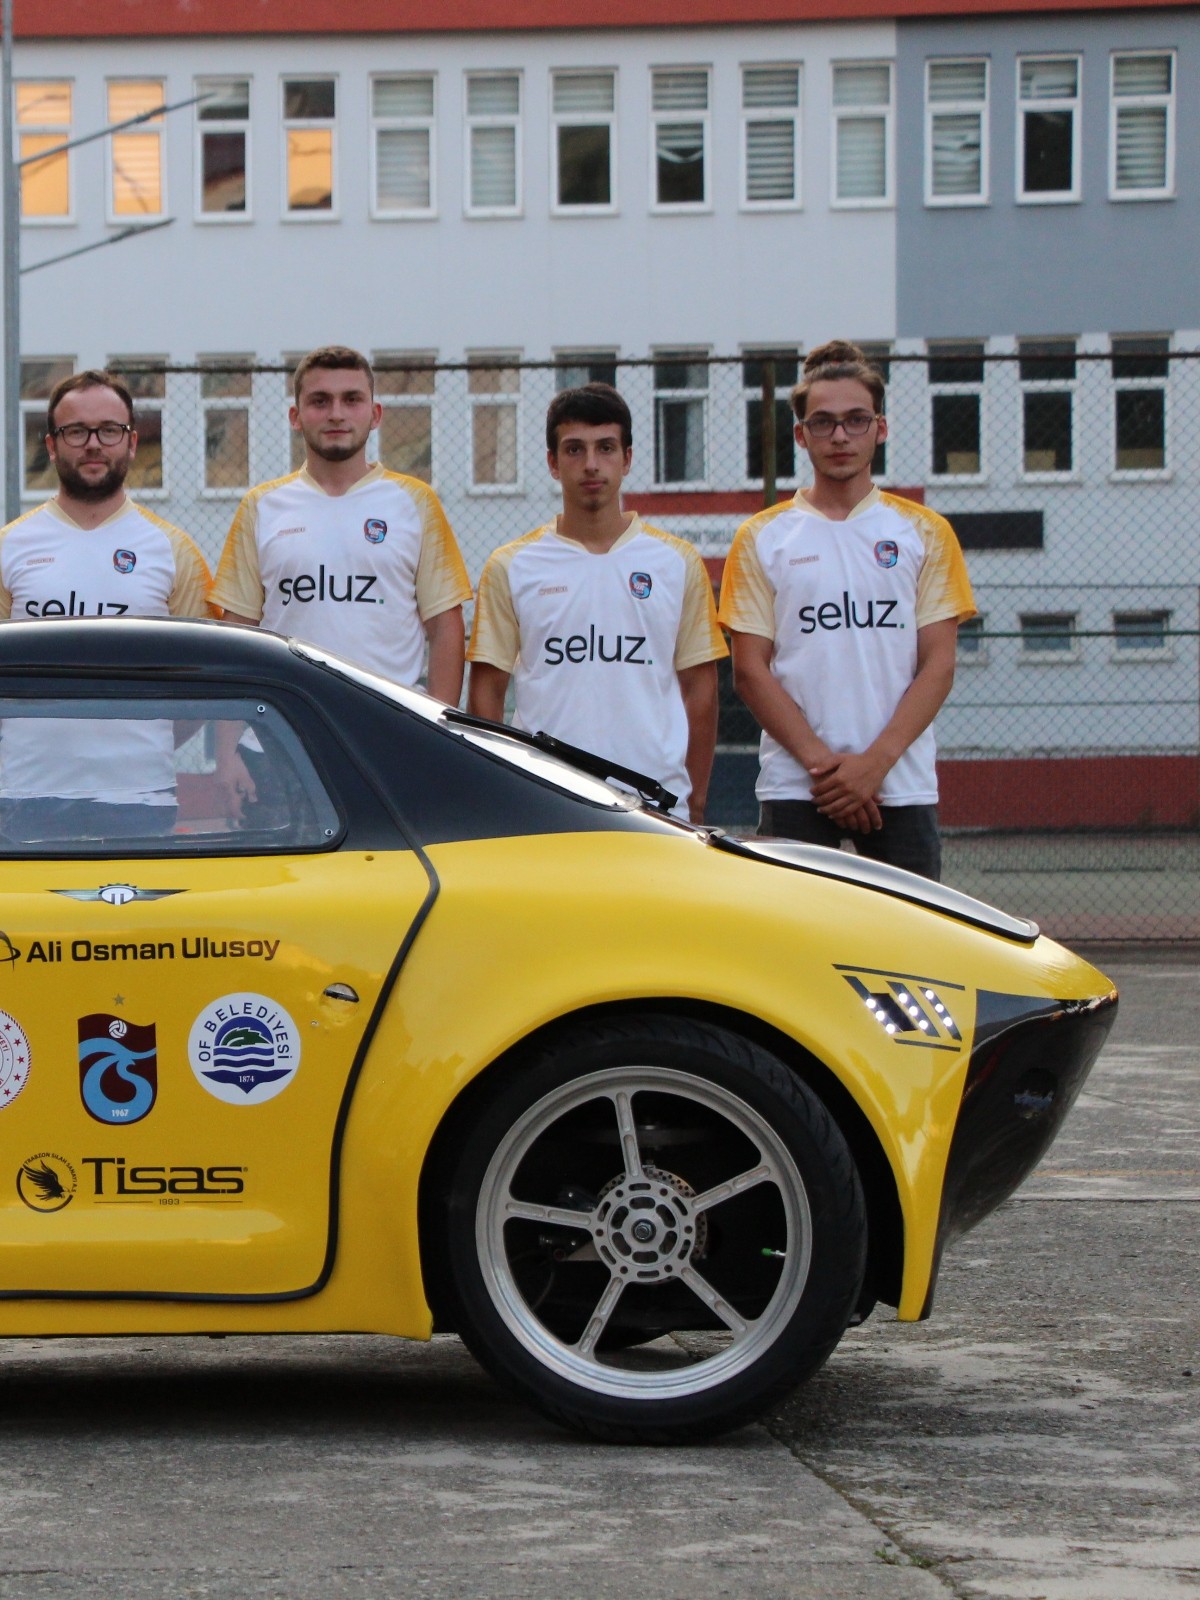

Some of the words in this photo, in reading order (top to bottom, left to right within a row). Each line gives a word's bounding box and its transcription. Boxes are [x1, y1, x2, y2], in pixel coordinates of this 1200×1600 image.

[799, 591, 905, 634] seluz.
[544, 624, 653, 665] seluz.
[26, 941, 62, 962] Ali
[71, 940, 175, 962] Osman
[181, 937, 281, 961] Ulusoy
[204, 1002, 292, 1059] BELEDİYESİ
[198, 1040, 211, 1062] OF
[239, 1075, 255, 1083] 1874
[111, 1109, 129, 1117] 1967
[159, 1198, 180, 1206] 1993
